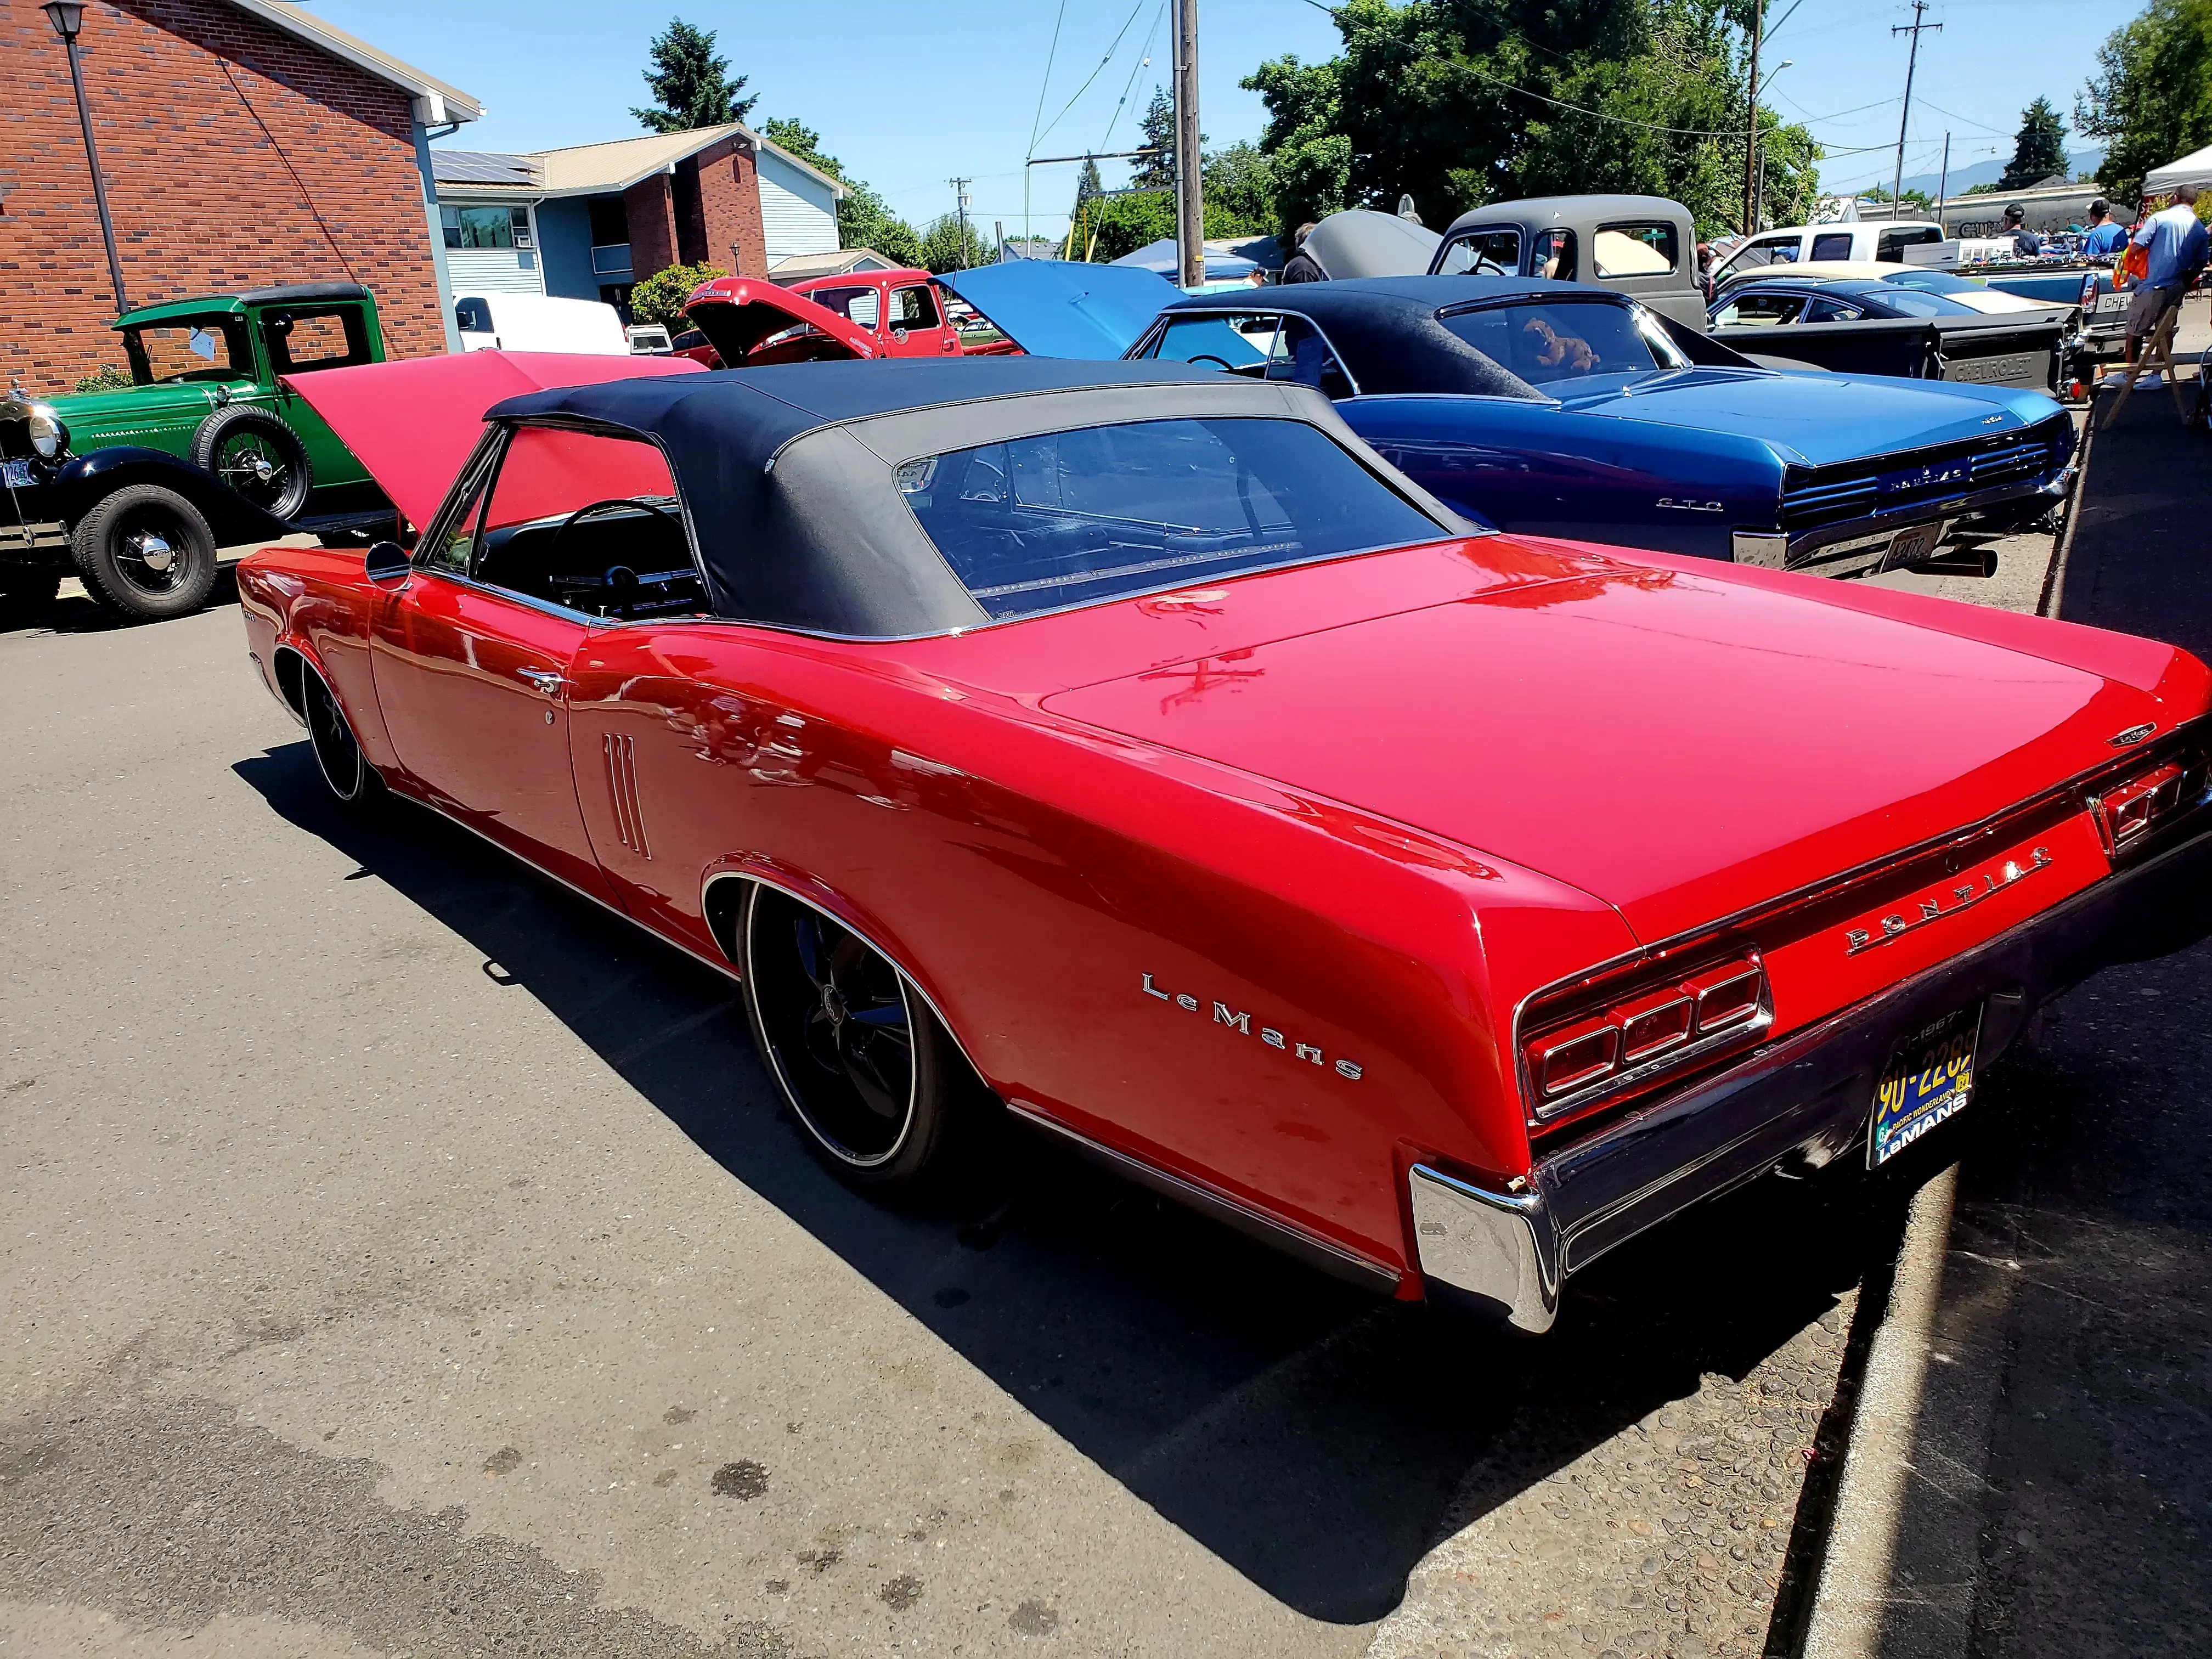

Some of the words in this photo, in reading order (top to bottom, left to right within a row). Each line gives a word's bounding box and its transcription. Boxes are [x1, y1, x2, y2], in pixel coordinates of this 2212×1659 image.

[1656, 498, 1723, 511] GTO
[1845, 847, 2053, 958] PONTIAC
[1142, 972, 1363, 1081] LeMans
[1893, 1113, 1912, 1130] PACIFIC
[1913, 1090, 1950, 1118] WONDERLAND
